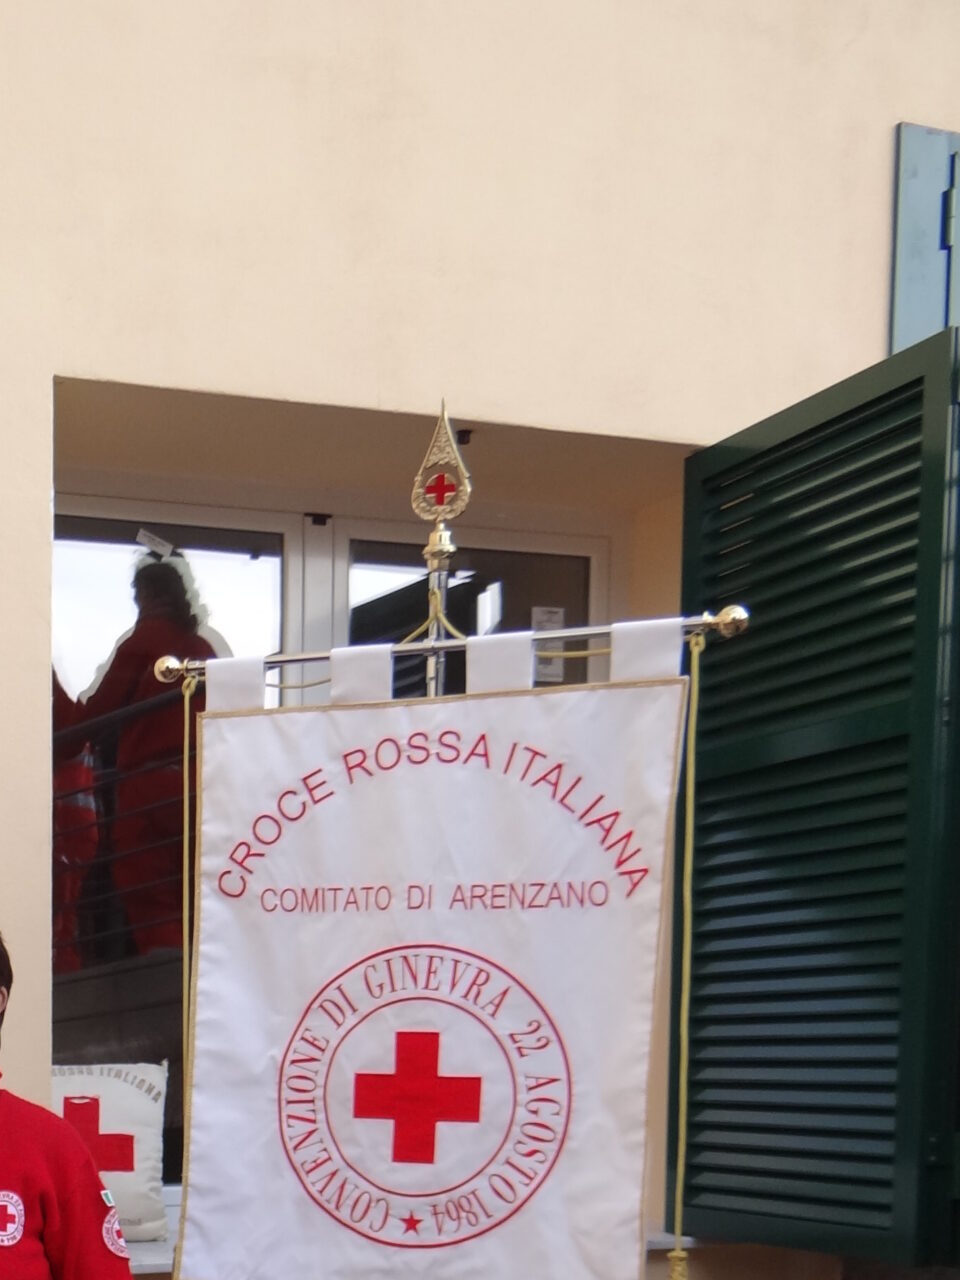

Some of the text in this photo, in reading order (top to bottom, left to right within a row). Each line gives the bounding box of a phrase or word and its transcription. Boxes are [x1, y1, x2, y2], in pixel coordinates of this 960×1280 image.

[217, 730, 650, 899] CROCE ROSSA ITALIANA
[260, 881, 609, 912] COMITATO DI ARENZANO
[99, 1066, 162, 1104] ITALIANA
[285, 954, 562, 1236] CONVENZIONE DI GINEVRA 22 AGOSTO 1864
